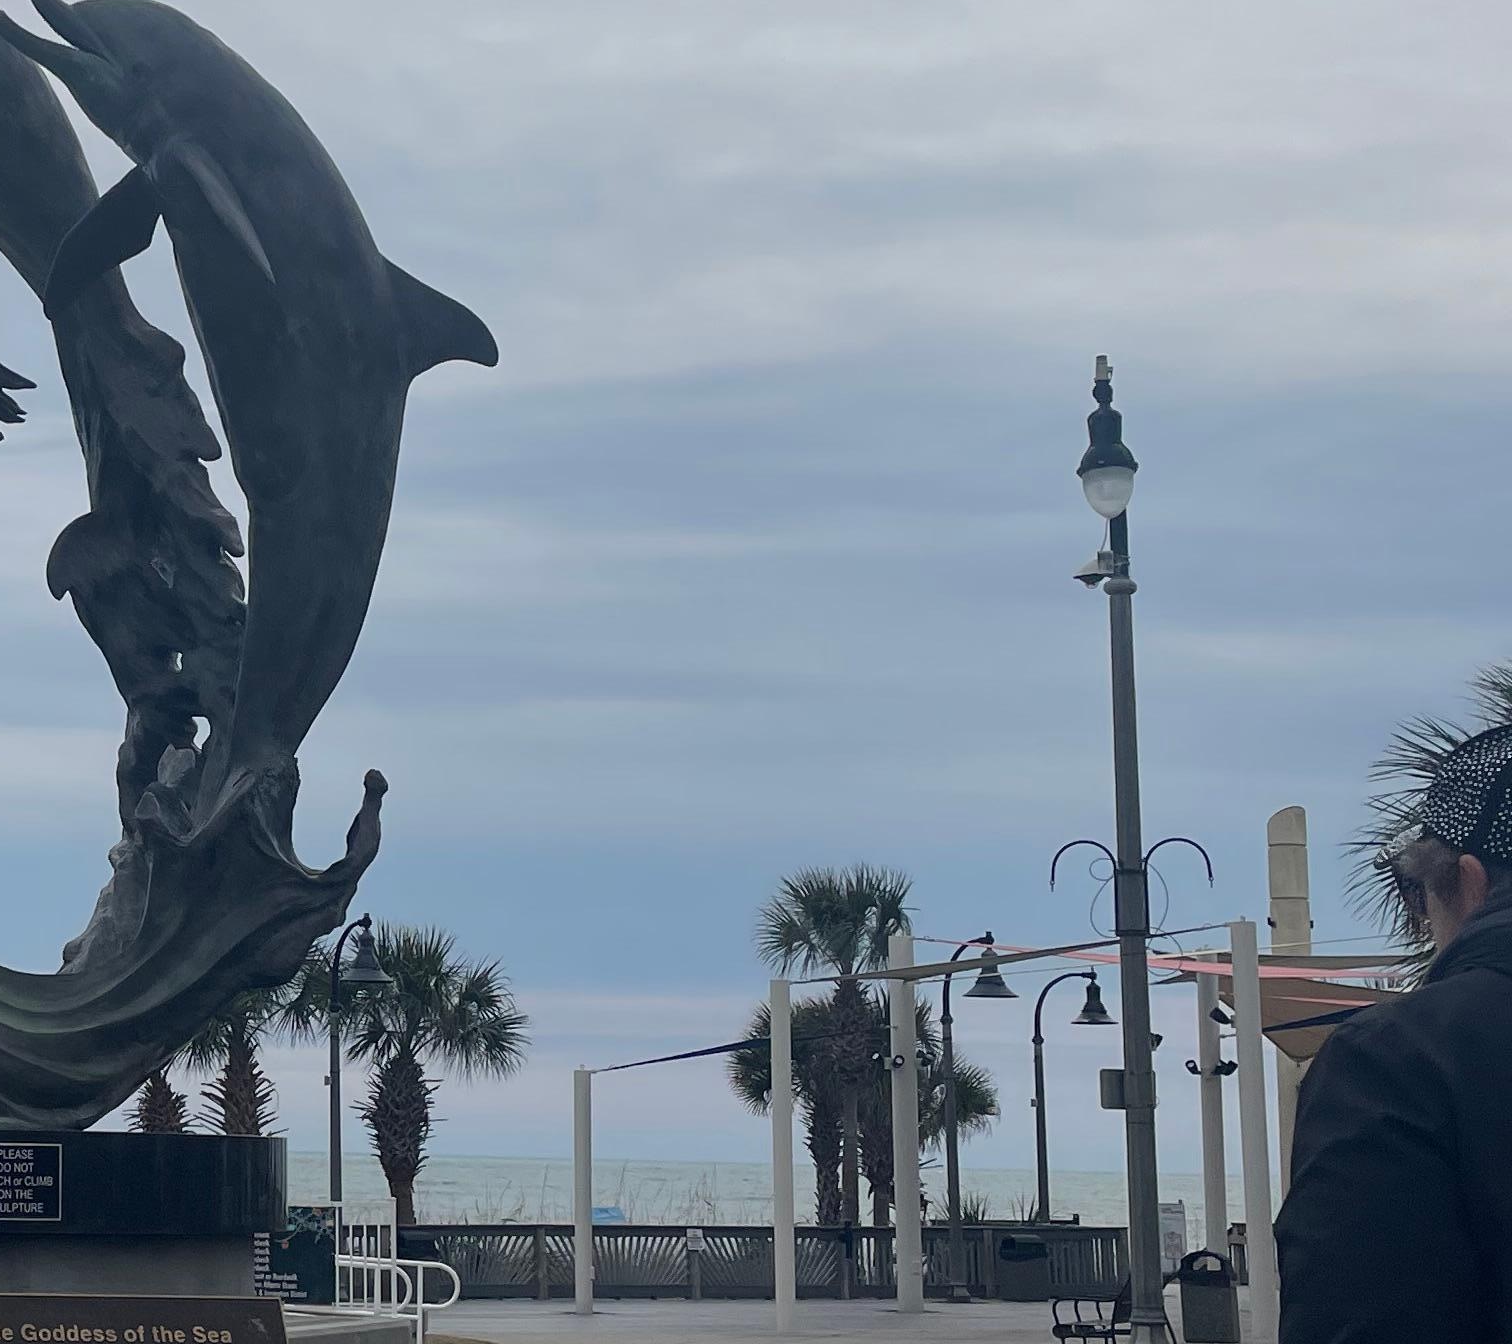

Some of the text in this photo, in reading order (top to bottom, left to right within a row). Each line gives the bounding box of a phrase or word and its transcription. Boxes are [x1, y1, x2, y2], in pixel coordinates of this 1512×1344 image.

[14, 1163, 34, 1172] NOT
[13, 1178, 22, 1186] or
[24, 1176, 53, 1186] CLIMB
[15, 1190, 33, 1199] THE
[20, 1323, 118, 1342] Goddess
[124, 1326, 144, 1342] of
[152, 1326, 186, 1343] the
[192, 1326, 233, 1343] Sea
